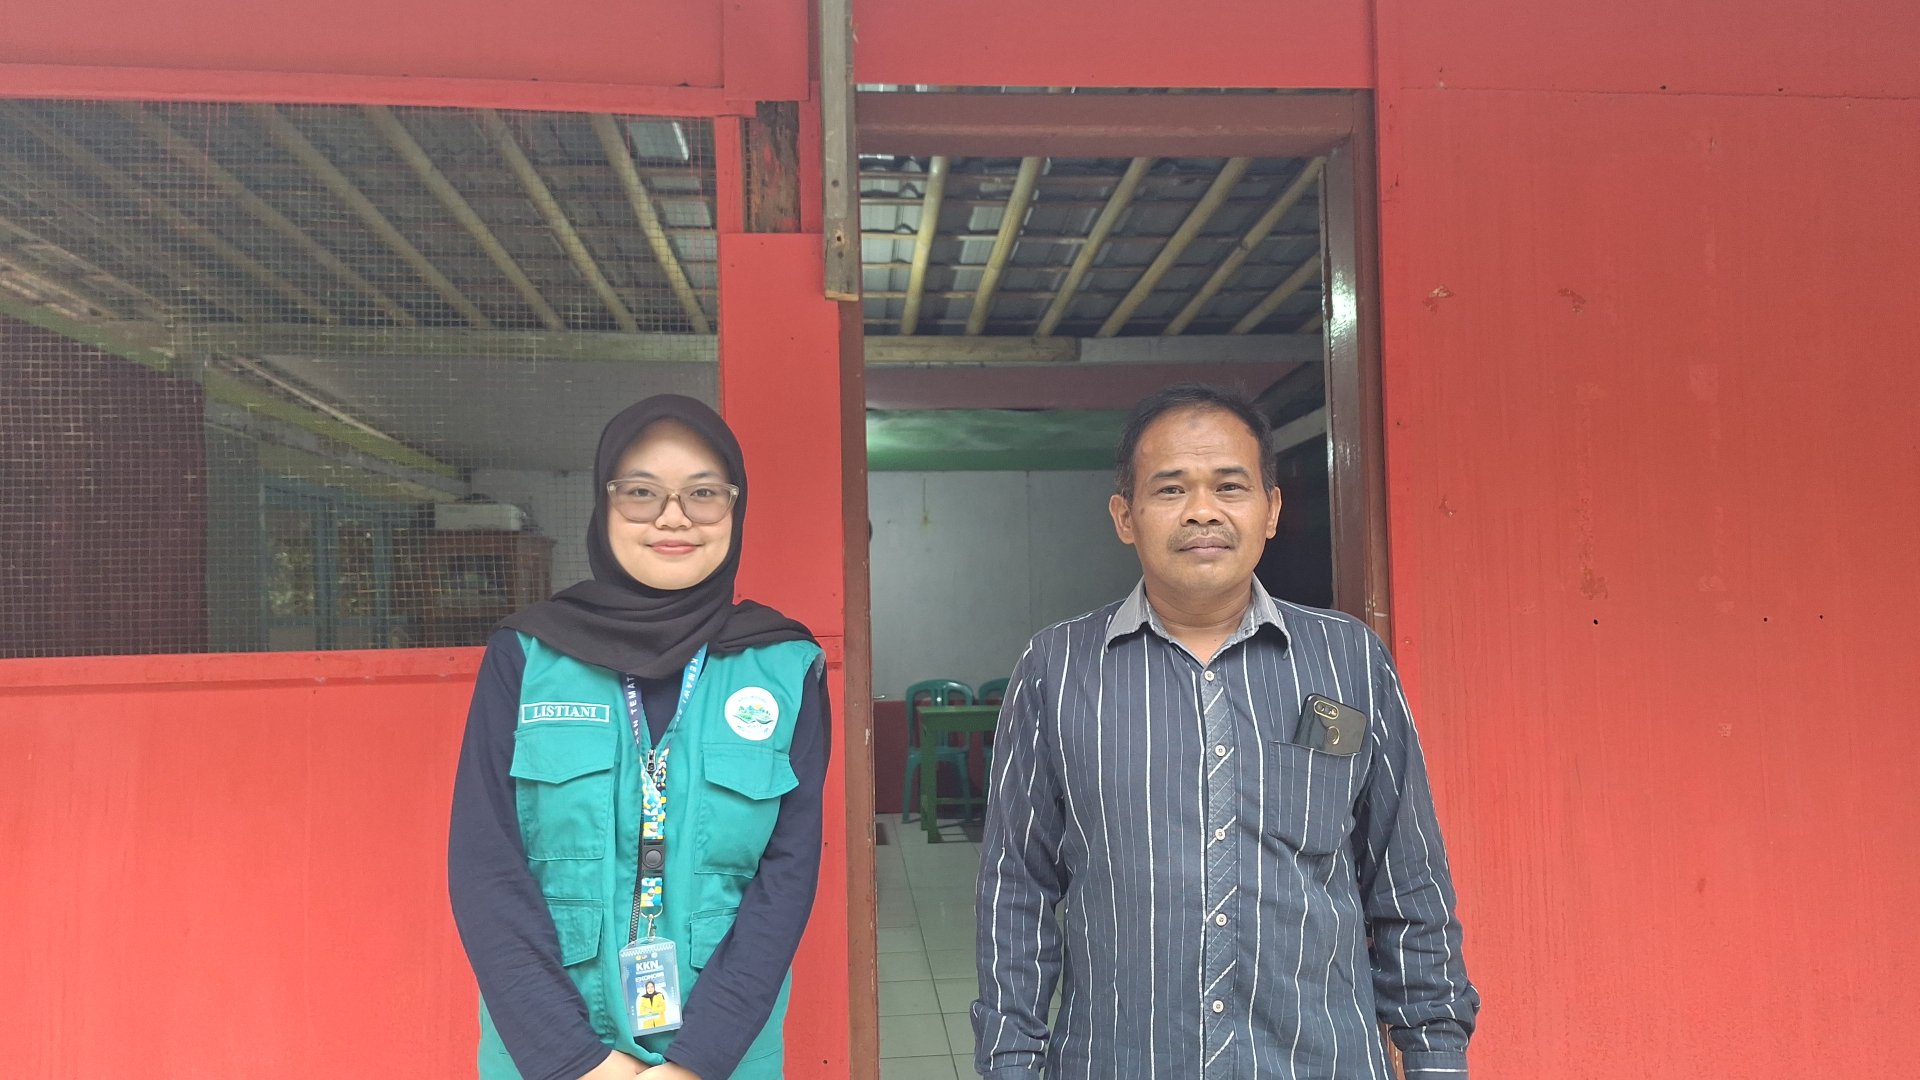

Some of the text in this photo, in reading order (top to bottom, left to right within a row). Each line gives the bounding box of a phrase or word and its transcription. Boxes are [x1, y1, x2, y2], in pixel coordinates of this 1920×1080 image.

[626, 672, 638, 716] TEMAT
[683, 658, 699, 704] KEMAWI
[533, 705, 597, 719] LISTIANI
[636, 960, 659, 971] KKN
